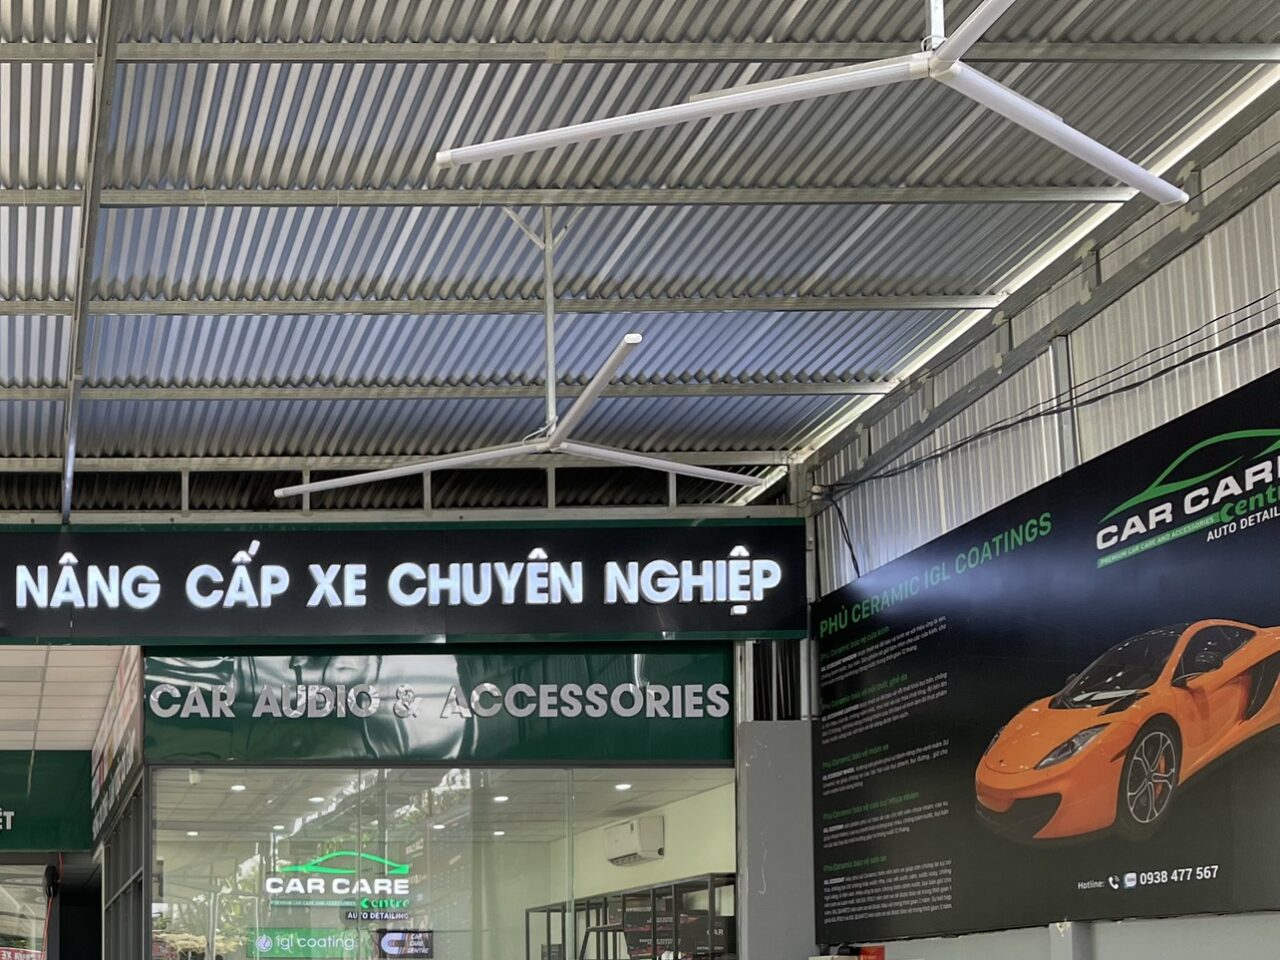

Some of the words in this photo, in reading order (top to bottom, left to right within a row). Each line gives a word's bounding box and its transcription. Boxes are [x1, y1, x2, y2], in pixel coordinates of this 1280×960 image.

[1096, 502, 1173, 550] CAR
[1184, 455, 1280, 515] CAR
[1219, 484, 1280, 523] Cent
[1207, 522, 1237, 542] AUTO
[15, 551, 161, 610] NÂNG
[185, 539, 290, 609] CẤP
[305, 562, 368, 608] XE
[387, 547, 584, 608] CHUYÊN
[603, 544, 782, 616] NGHIỆP
[820, 605, 848, 638] PHỦ
[851, 575, 920, 623] CERAMIC
[924, 561, 951, 590] IGL
[955, 512, 1052, 575] COATINGS
[149, 683, 236, 718] CAR
[252, 683, 381, 718] AUDIO
[393, 683, 419, 718] &
[440, 682, 730, 718] ACCESSORIES
[265, 877, 325, 894] CAR
[332, 877, 410, 895] CARE
[1077, 880, 1105, 890] Hotline:
[1139, 870, 1168, 885] 0938
[1171, 868, 1193, 882] 477
[1196, 865, 1219, 880] 567
[370, 911, 410, 920] DETAILING
